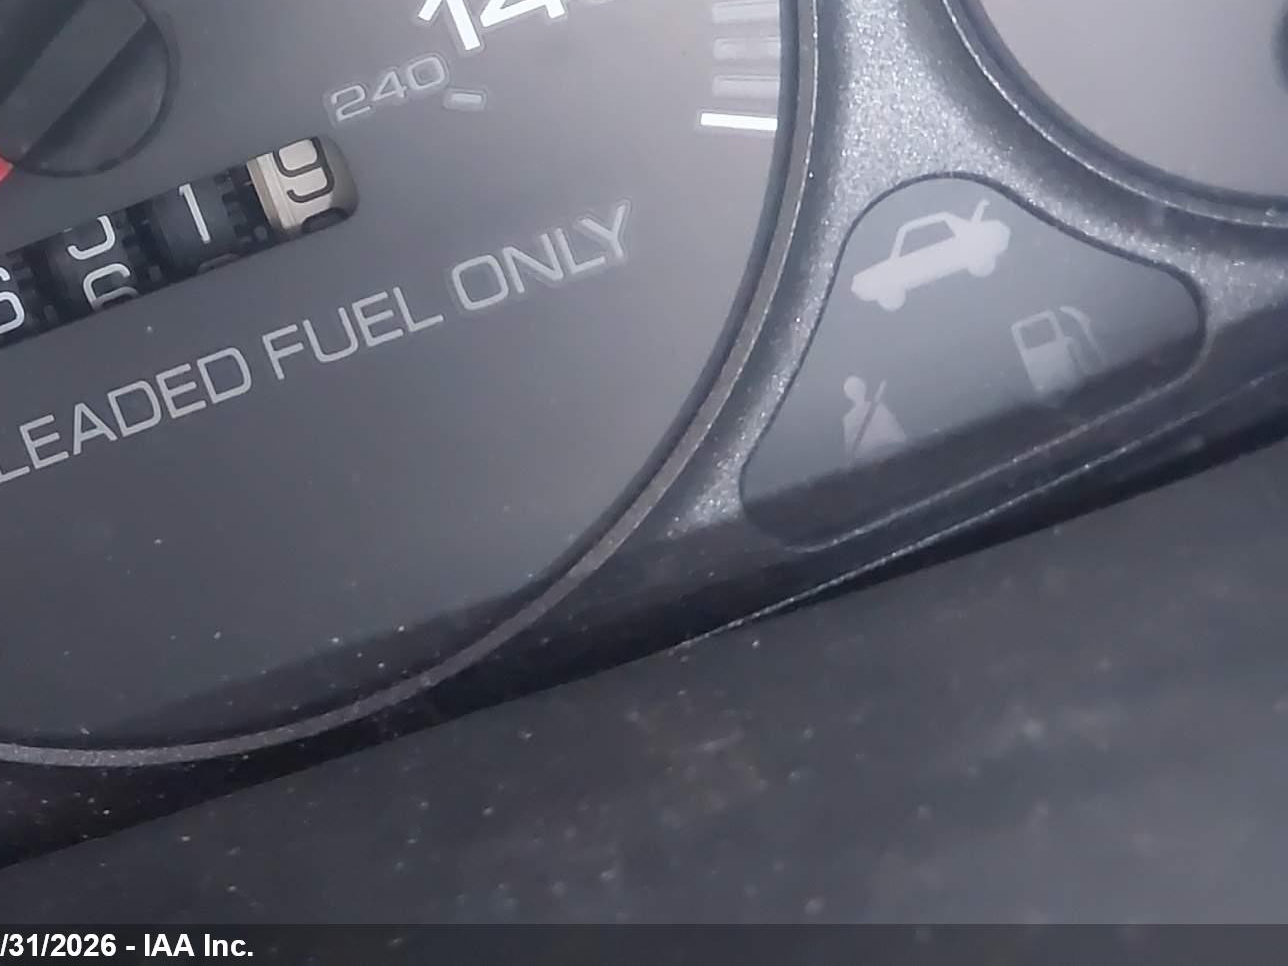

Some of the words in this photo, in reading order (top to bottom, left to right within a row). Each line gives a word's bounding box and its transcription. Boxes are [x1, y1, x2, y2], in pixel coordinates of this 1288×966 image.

[330, 55, 446, 122] 240
[260, 286, 444, 379] FUEL
[451, 201, 629, 311] ONLY
